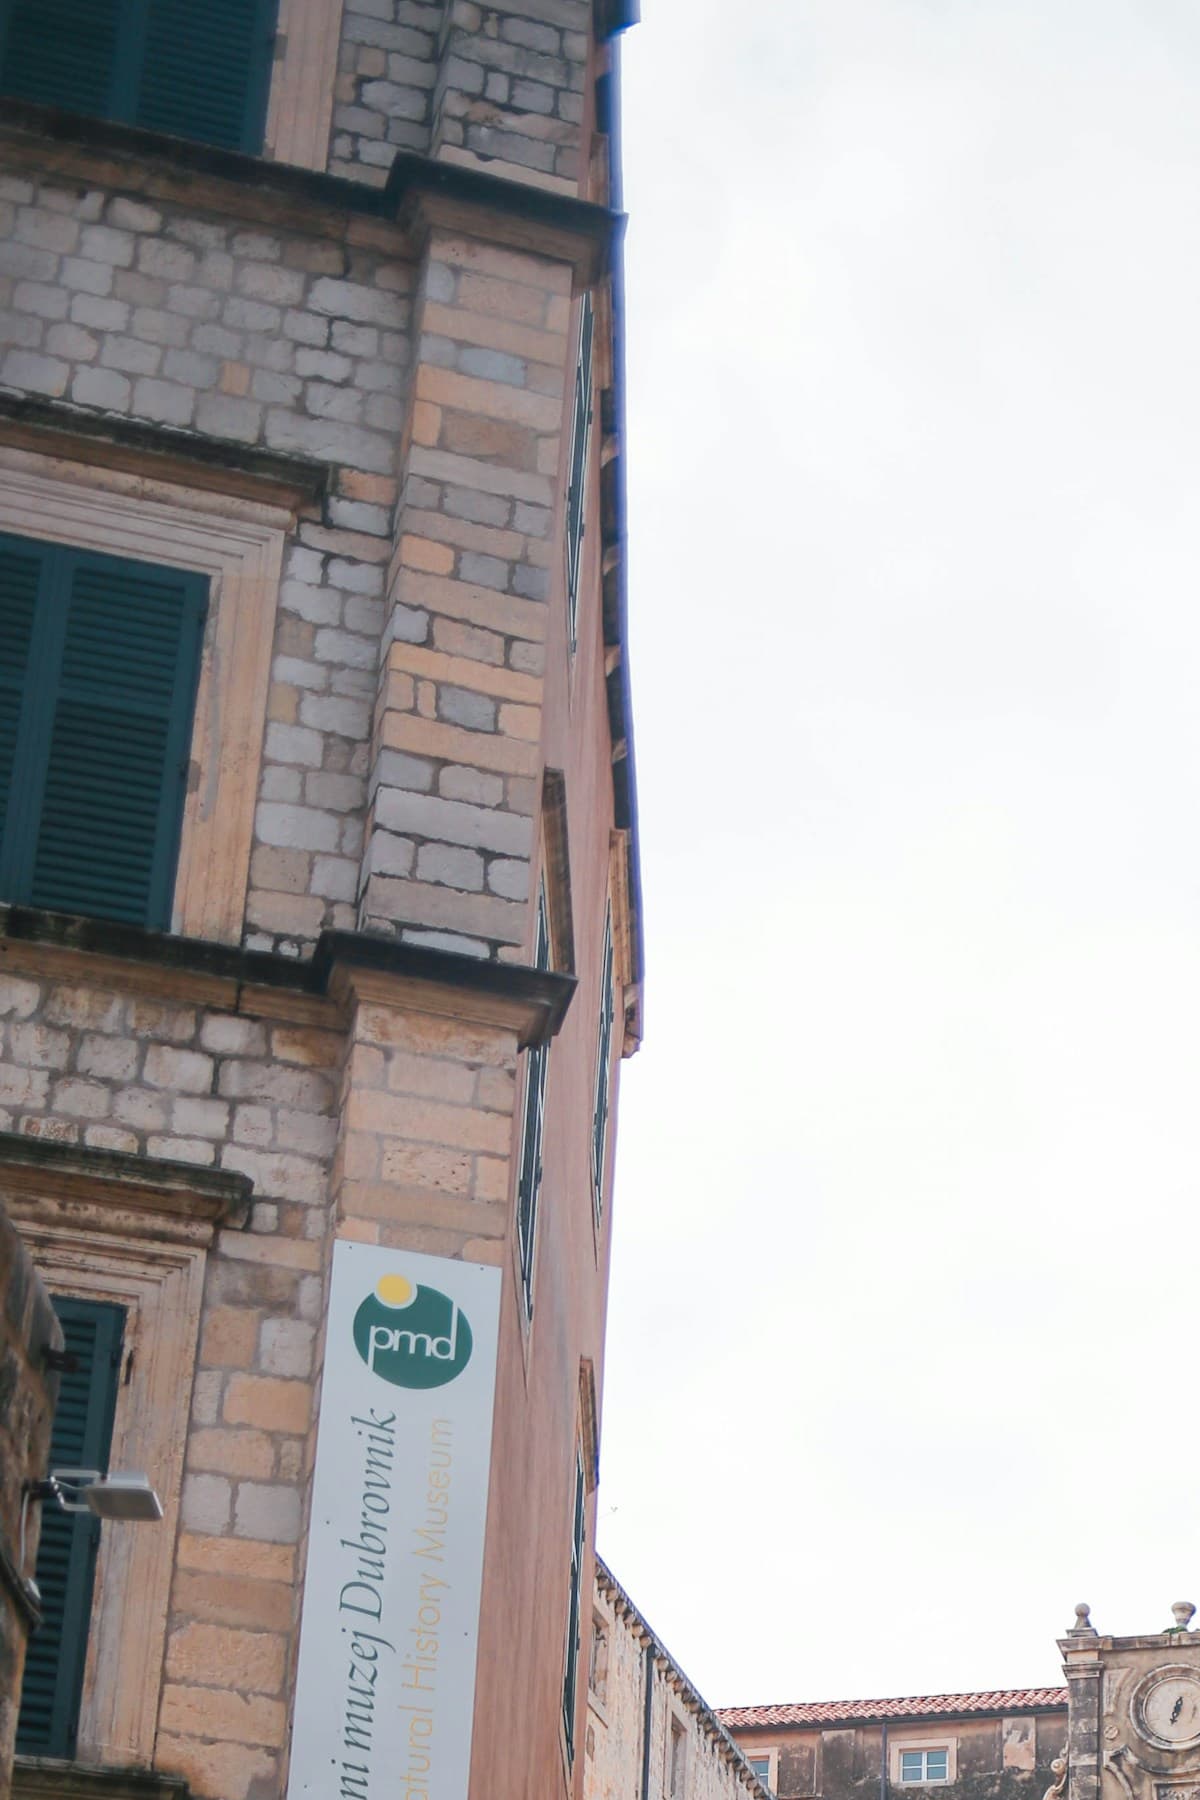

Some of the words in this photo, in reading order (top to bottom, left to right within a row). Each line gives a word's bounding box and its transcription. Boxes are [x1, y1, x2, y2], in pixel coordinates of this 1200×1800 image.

[367, 1301, 459, 1371] pmd
[338, 1407, 397, 1624] Dubrovnik
[411, 1418, 456, 1562] Museum
[340, 1627, 397, 1752] muzej
[401, 1572, 452, 1691] History
